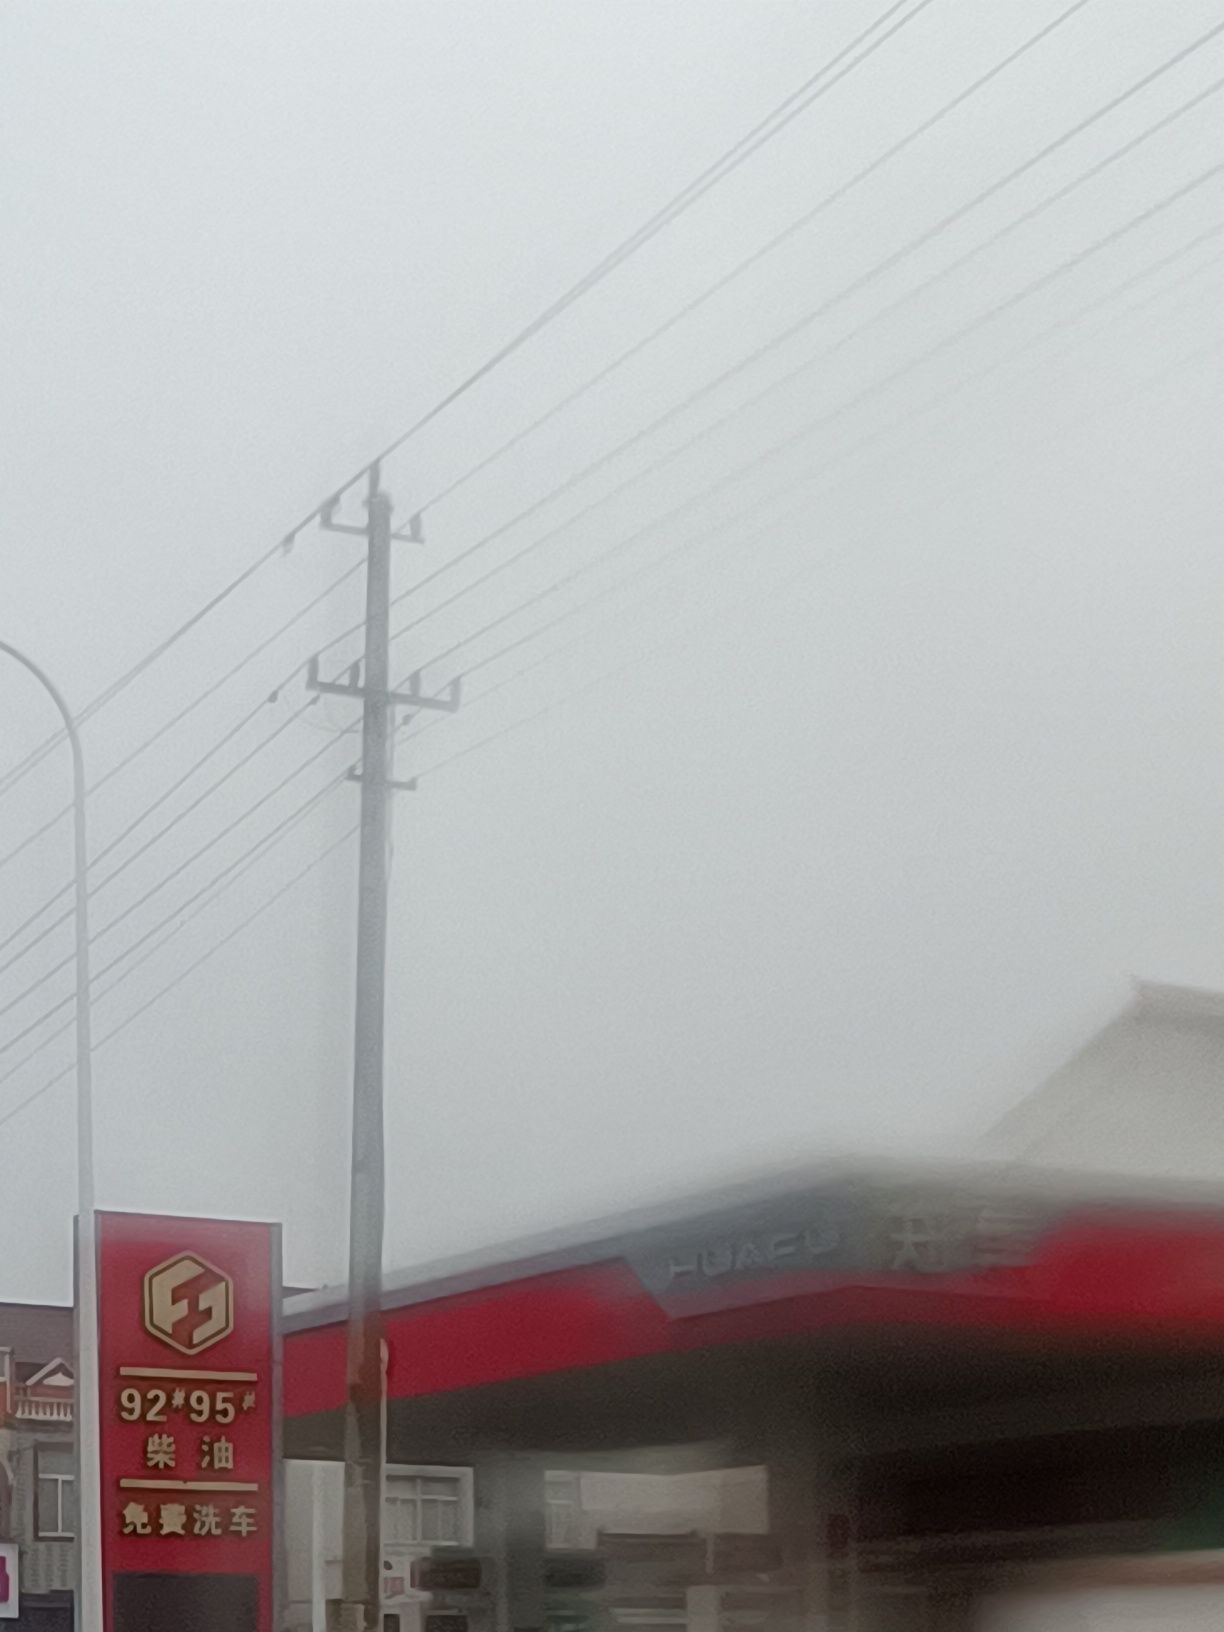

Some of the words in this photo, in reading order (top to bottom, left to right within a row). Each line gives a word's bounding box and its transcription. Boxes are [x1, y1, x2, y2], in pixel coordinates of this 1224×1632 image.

[146, 1433, 234, 1469] 柴油
[122, 1502, 257, 1537] 免费洗车
